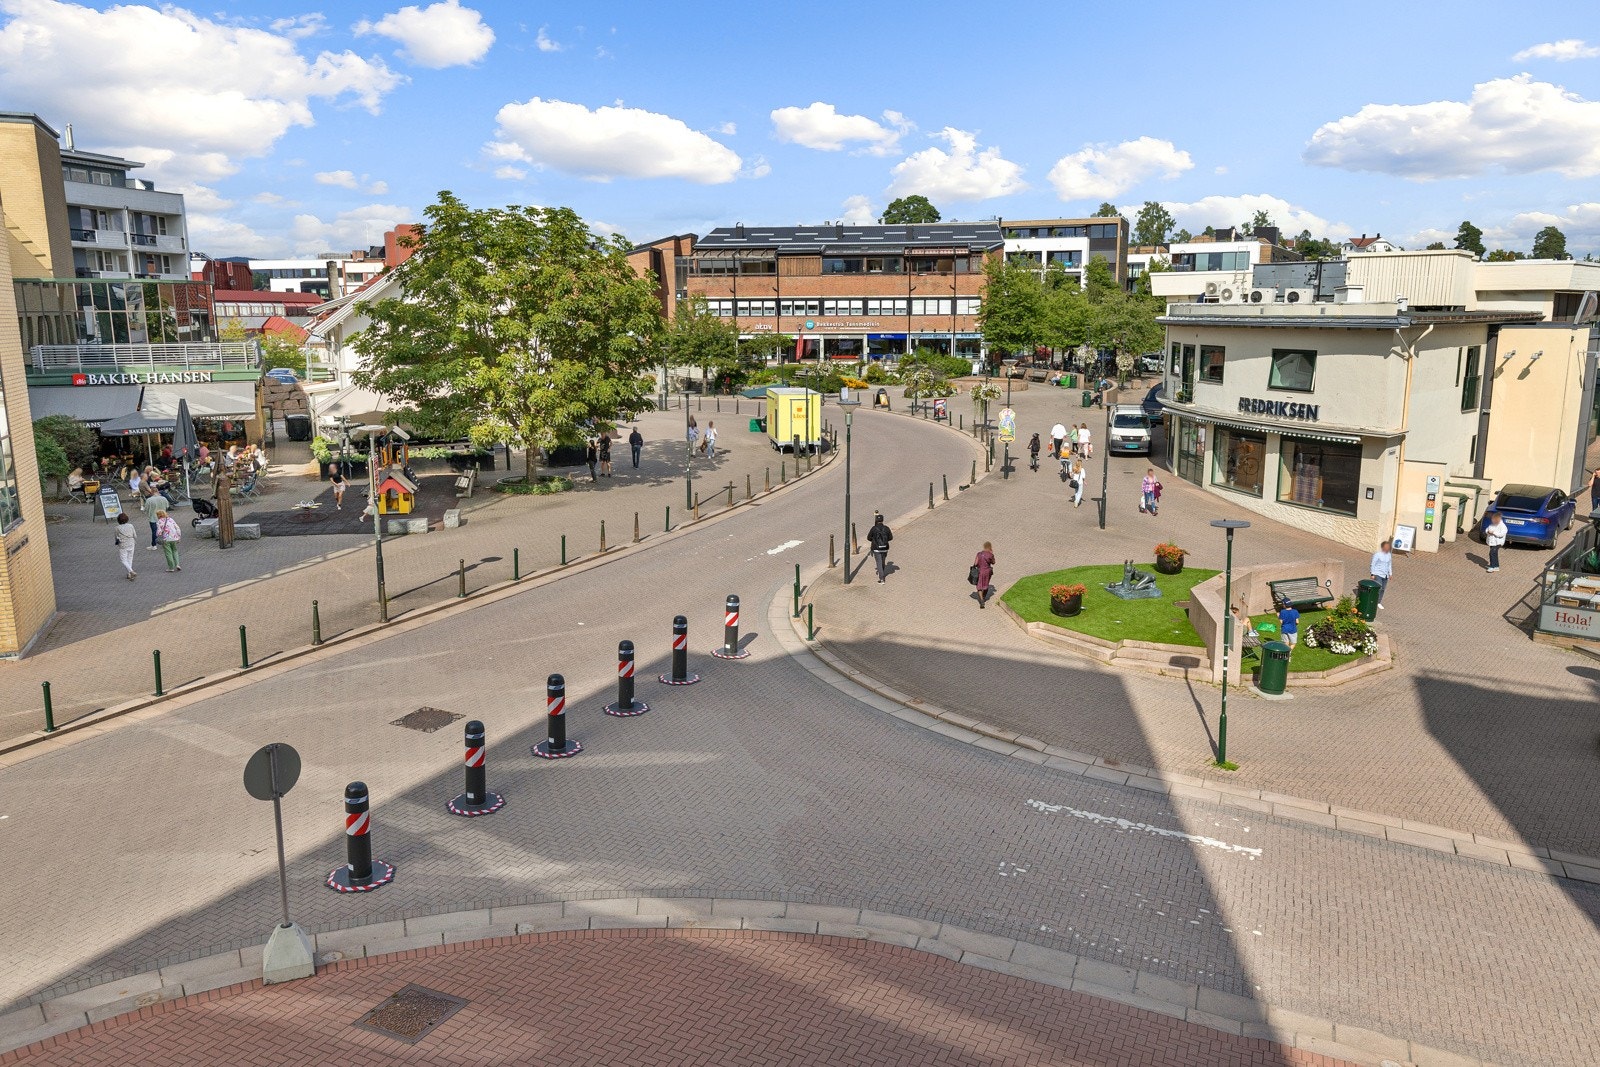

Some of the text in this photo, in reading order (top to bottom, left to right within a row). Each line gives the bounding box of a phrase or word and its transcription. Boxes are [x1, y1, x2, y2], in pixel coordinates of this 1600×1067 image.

[88, 373, 141, 385] BAKER
[146, 371, 212, 384] HANSEN
[1238, 397, 1319, 420] FREDRIKSEN
[1555, 611, 1592, 627] Hola!
